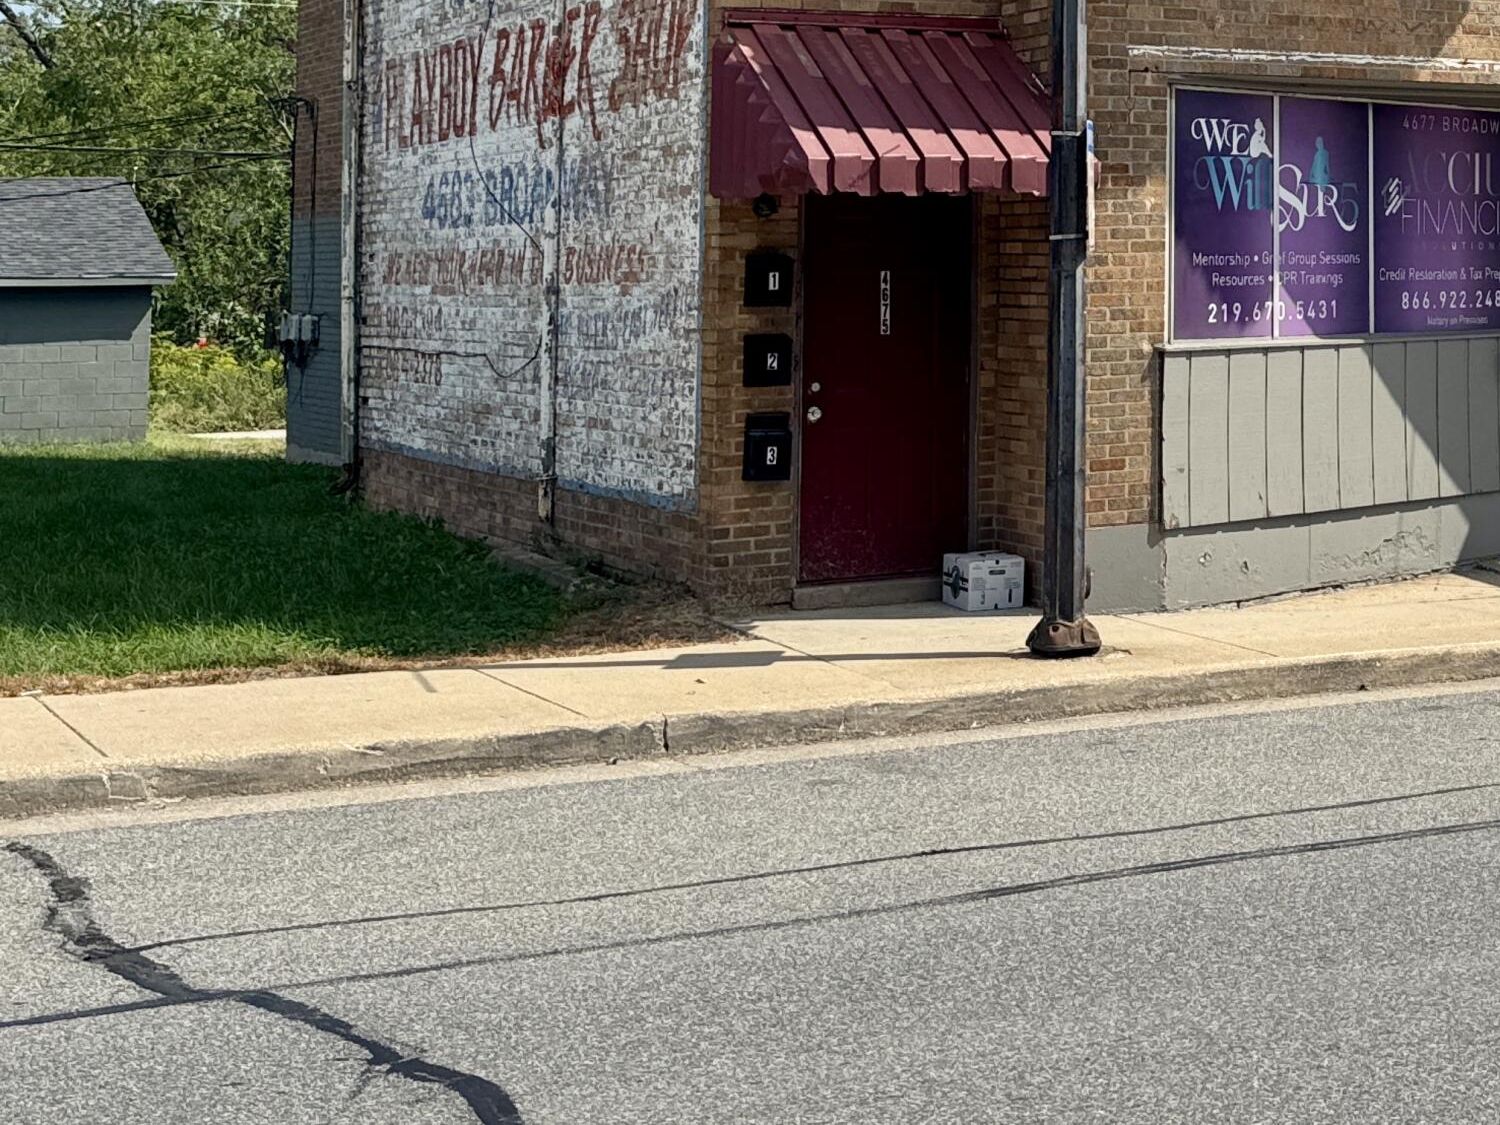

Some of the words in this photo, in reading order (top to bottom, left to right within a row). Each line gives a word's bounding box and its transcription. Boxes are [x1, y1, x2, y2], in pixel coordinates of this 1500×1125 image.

[384, 37, 483, 151] PLAYBOY
[1403, 115, 1435, 130] 4677
[1191, 118, 1250, 155] WE
[1192, 252, 1250, 267] Mentorship
[1262, 251, 1286, 265] Gref
[1288, 251, 1316, 267] Group
[1319, 251, 1361, 265] Sessions
[1212, 272, 1265, 286] Resources
[1301, 270, 1344, 287] Trainings
[1379, 268, 1405, 281] Credit
[1409, 268, 1458, 281] Restoration
[1470, 267, 1482, 280] Tax
[1208, 299, 1337, 323] 219.670.5431
[769, 355, 776, 368] 2
[769, 449, 776, 463] 3
